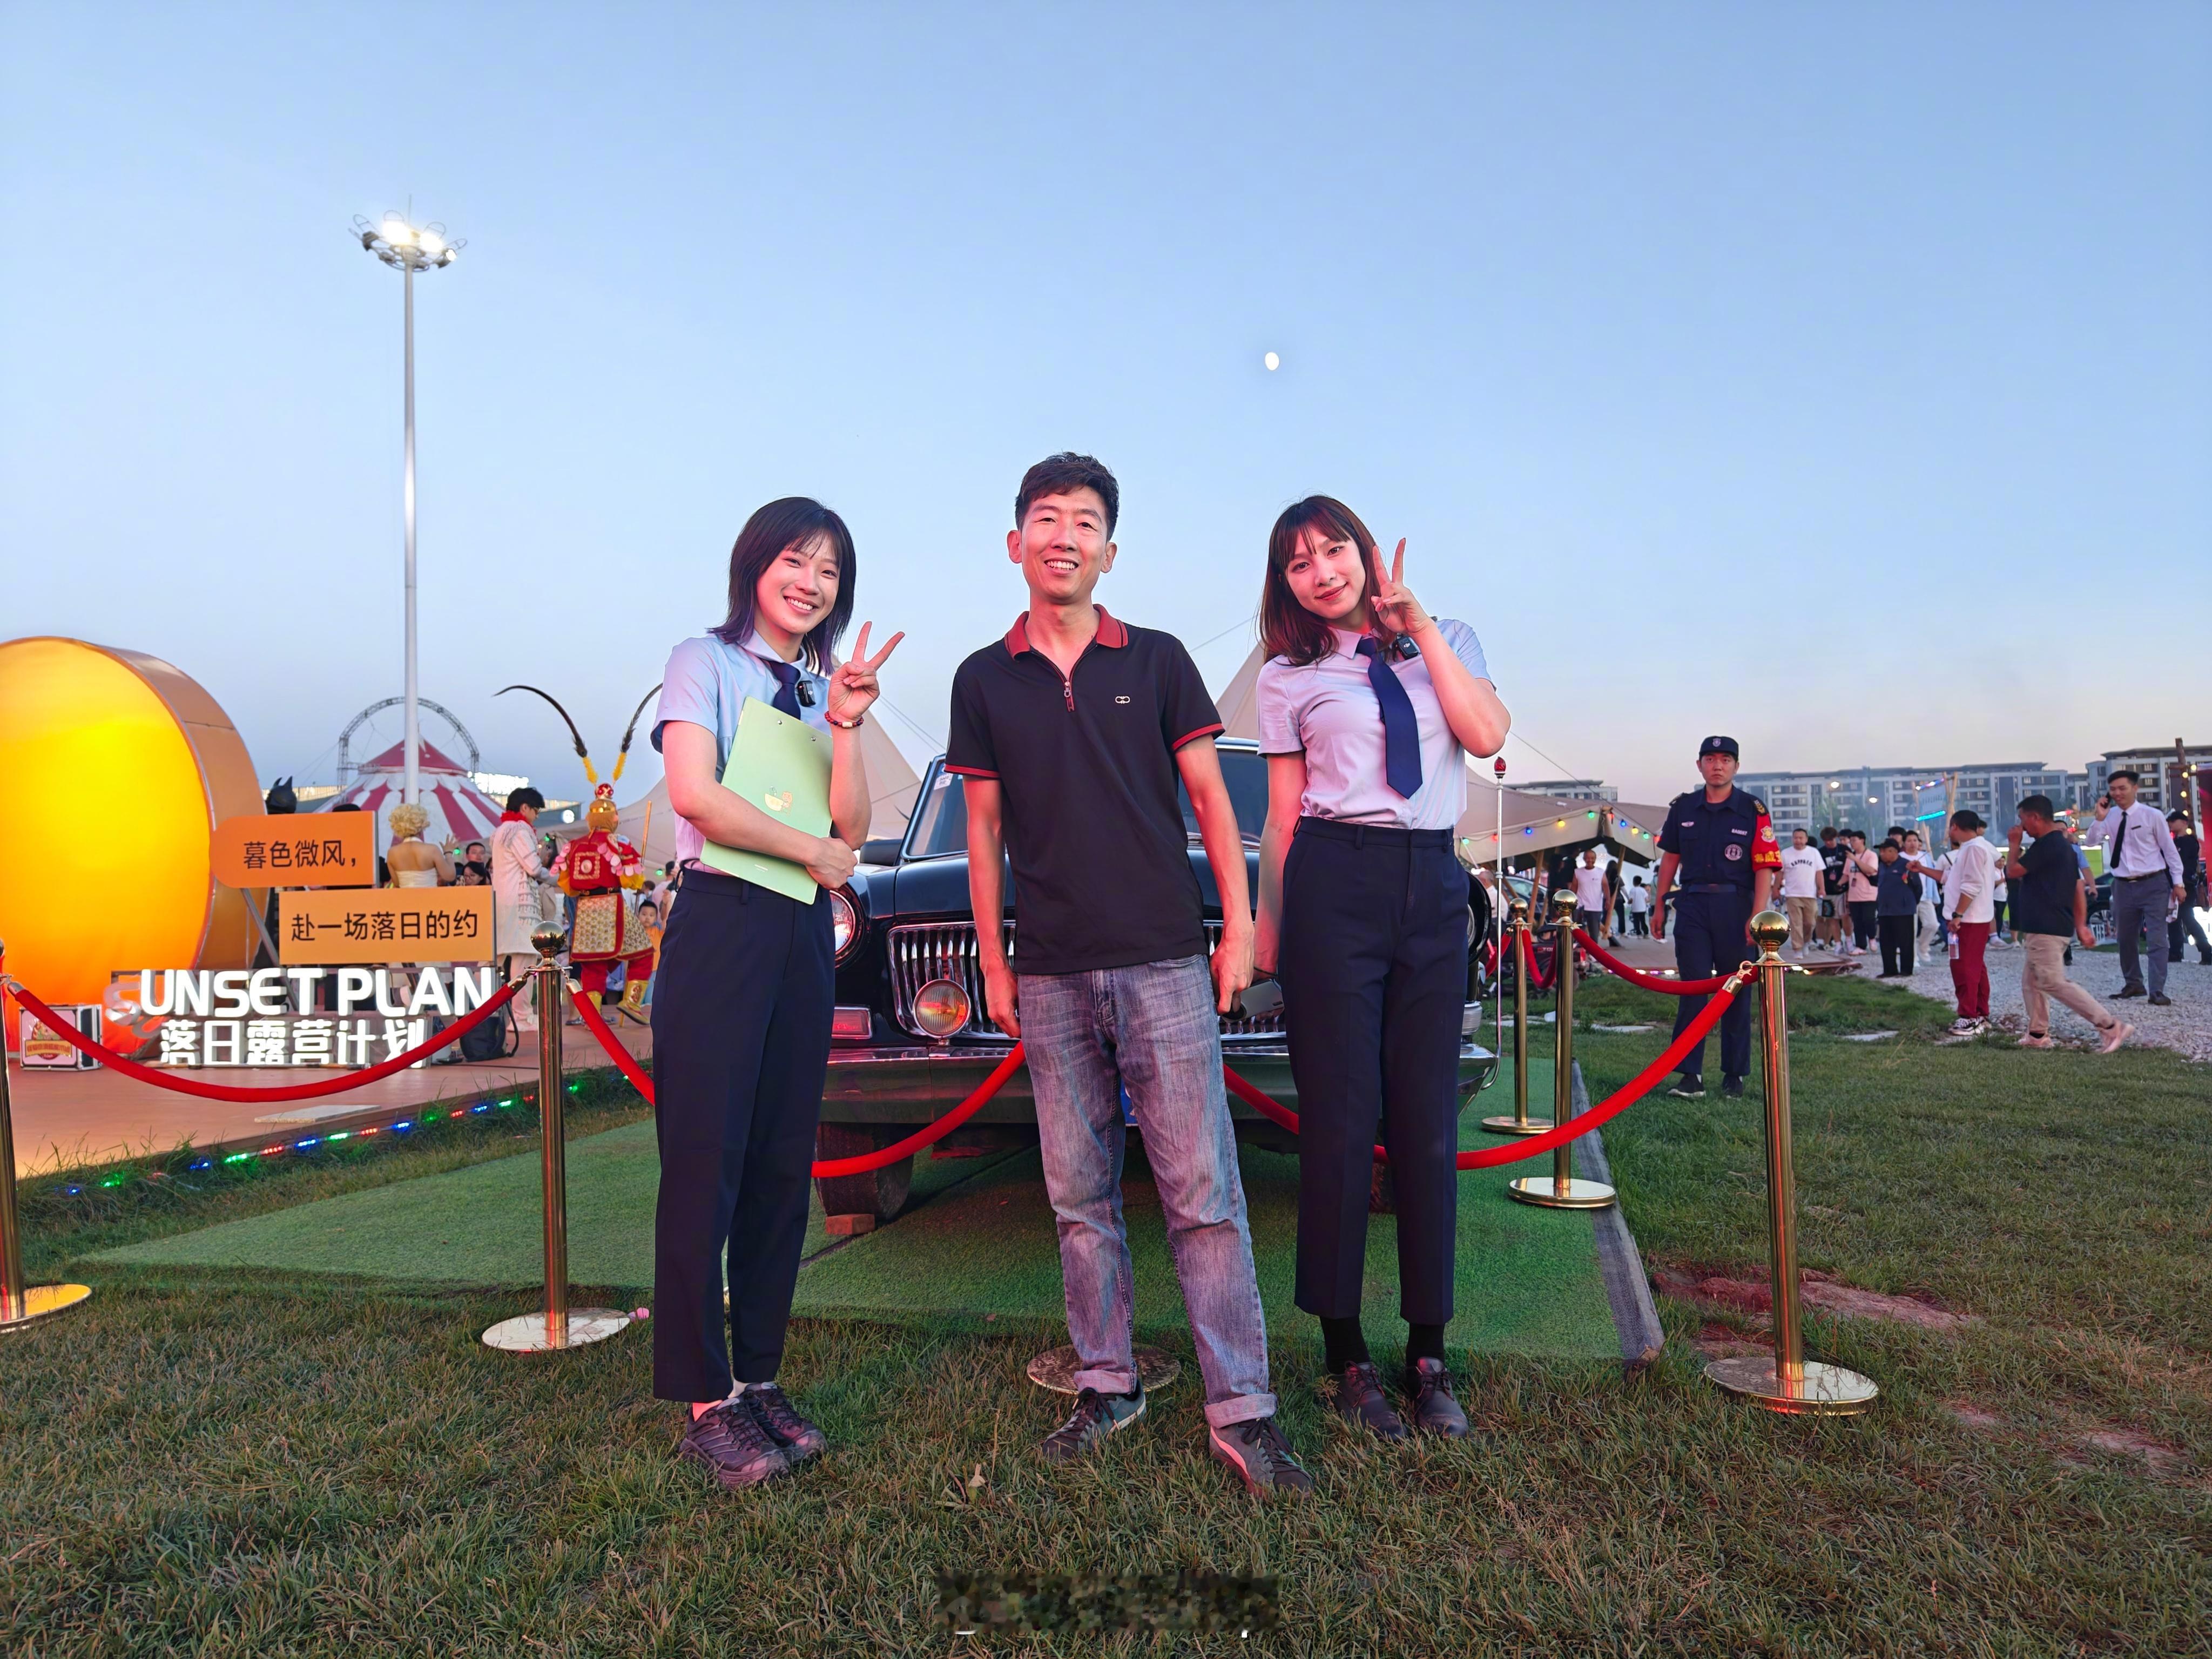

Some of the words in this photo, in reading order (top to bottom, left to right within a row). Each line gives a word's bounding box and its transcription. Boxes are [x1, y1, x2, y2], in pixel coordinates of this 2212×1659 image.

[243, 839, 357, 869] 暮色微风，
[291, 909, 478, 942] 赴一场落日的约
[338, 966, 495, 1017] PLAN
[160, 1019, 428, 1069] 落日露营计划
